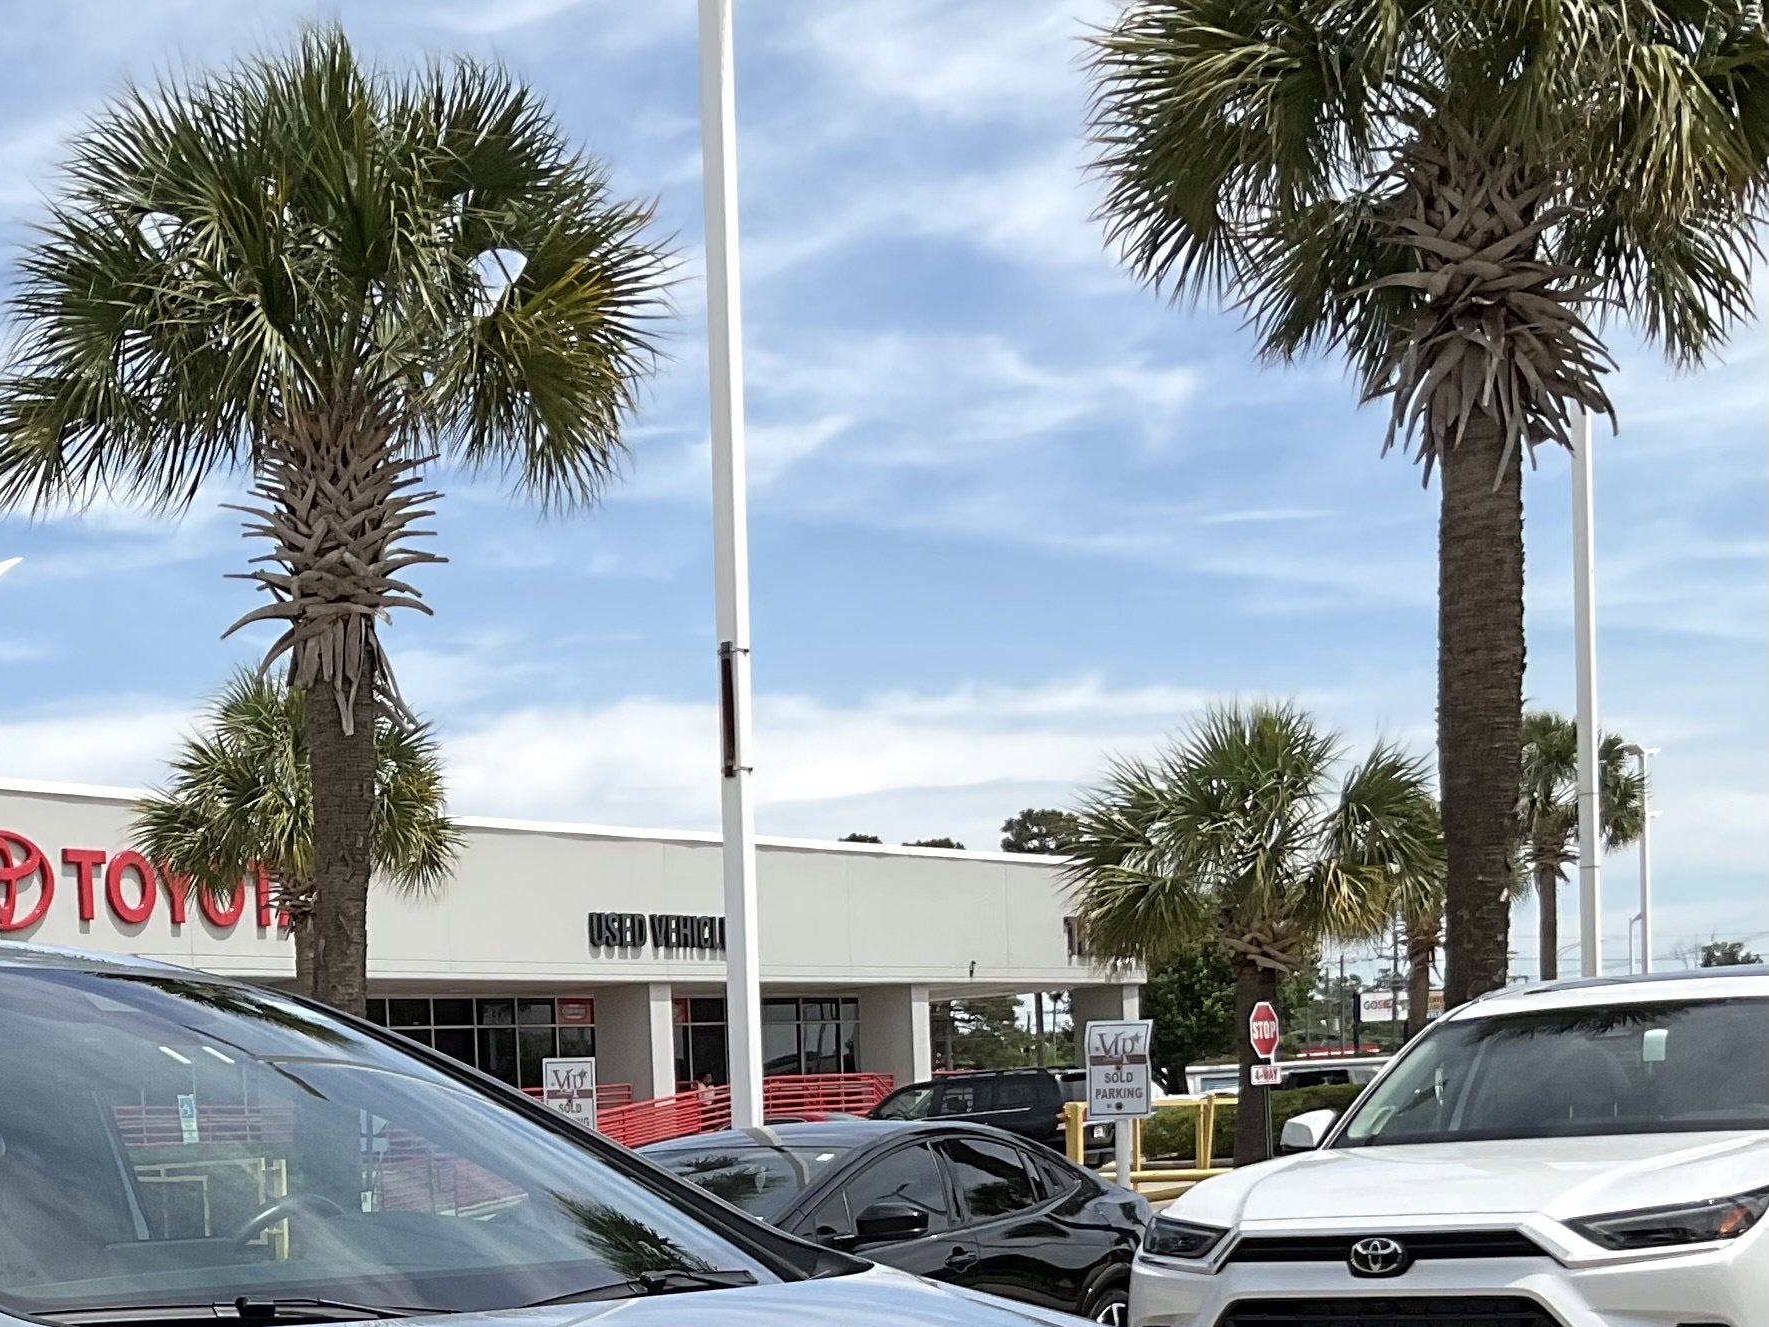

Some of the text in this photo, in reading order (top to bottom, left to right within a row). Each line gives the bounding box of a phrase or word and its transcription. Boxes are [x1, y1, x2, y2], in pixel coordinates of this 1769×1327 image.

[62, 848, 290, 928] TOYOT
[588, 912, 727, 952] USED VEHICL
[1252, 1021, 1276, 1039] STOP
[1104, 1071, 1133, 1084] SOLD
[1095, 1087, 1143, 1100] PARKING
[558, 1103, 582, 1113] SOLD
